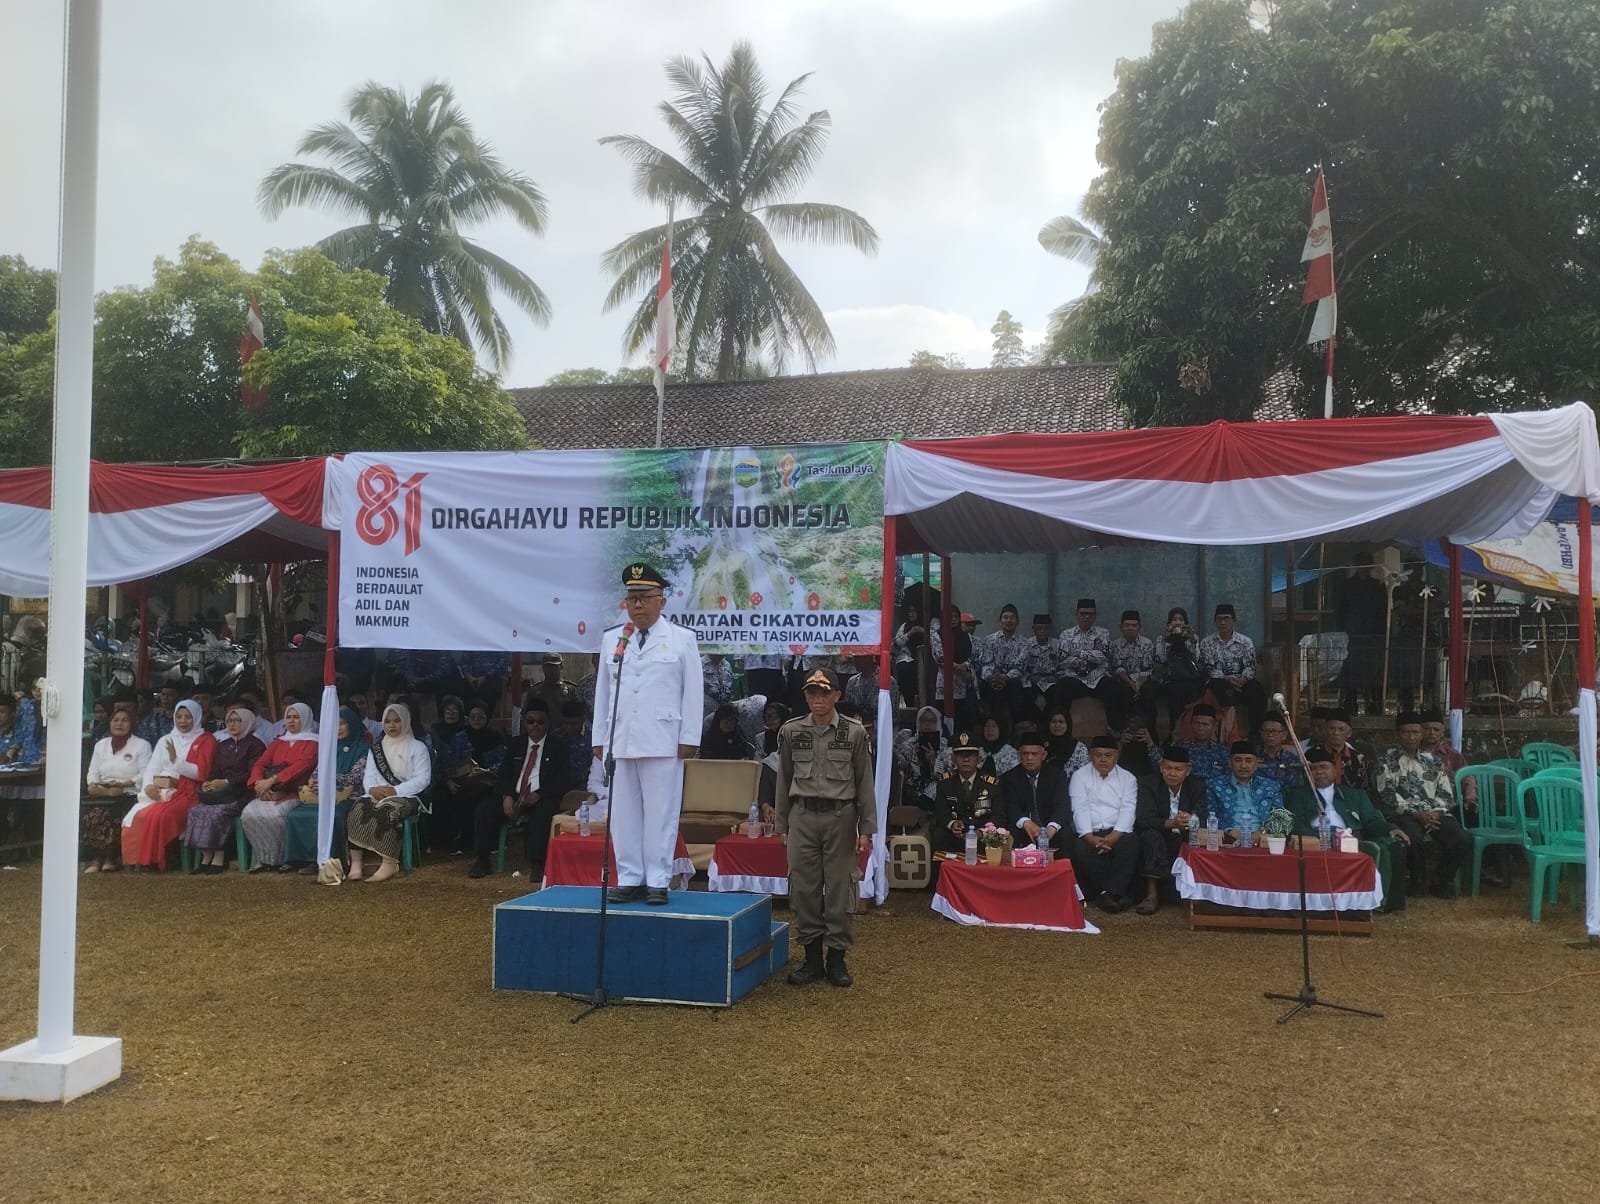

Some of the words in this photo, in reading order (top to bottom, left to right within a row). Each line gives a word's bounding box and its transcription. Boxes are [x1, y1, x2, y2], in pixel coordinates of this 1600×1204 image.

[807, 464, 874, 476] Tasikmalaya
[355, 463, 430, 558] 81
[431, 507, 568, 530] DIRGAHAYU
[578, 505, 700, 529] REPUBLIK
[708, 504, 852, 529] INDONESIA
[356, 567, 419, 579] INDONESIA
[356, 583, 424, 595] BERDAULAT
[355, 599, 381, 611] ADIL
[384, 600, 410, 611] DAN
[355, 615, 409, 627] MAKMUR
[661, 613, 743, 627] AMATAN
[749, 613, 860, 627] CIKATOMAS
[696, 630, 758, 641] BUPATEN
[762, 631, 860, 642] TASIKMALAYA
